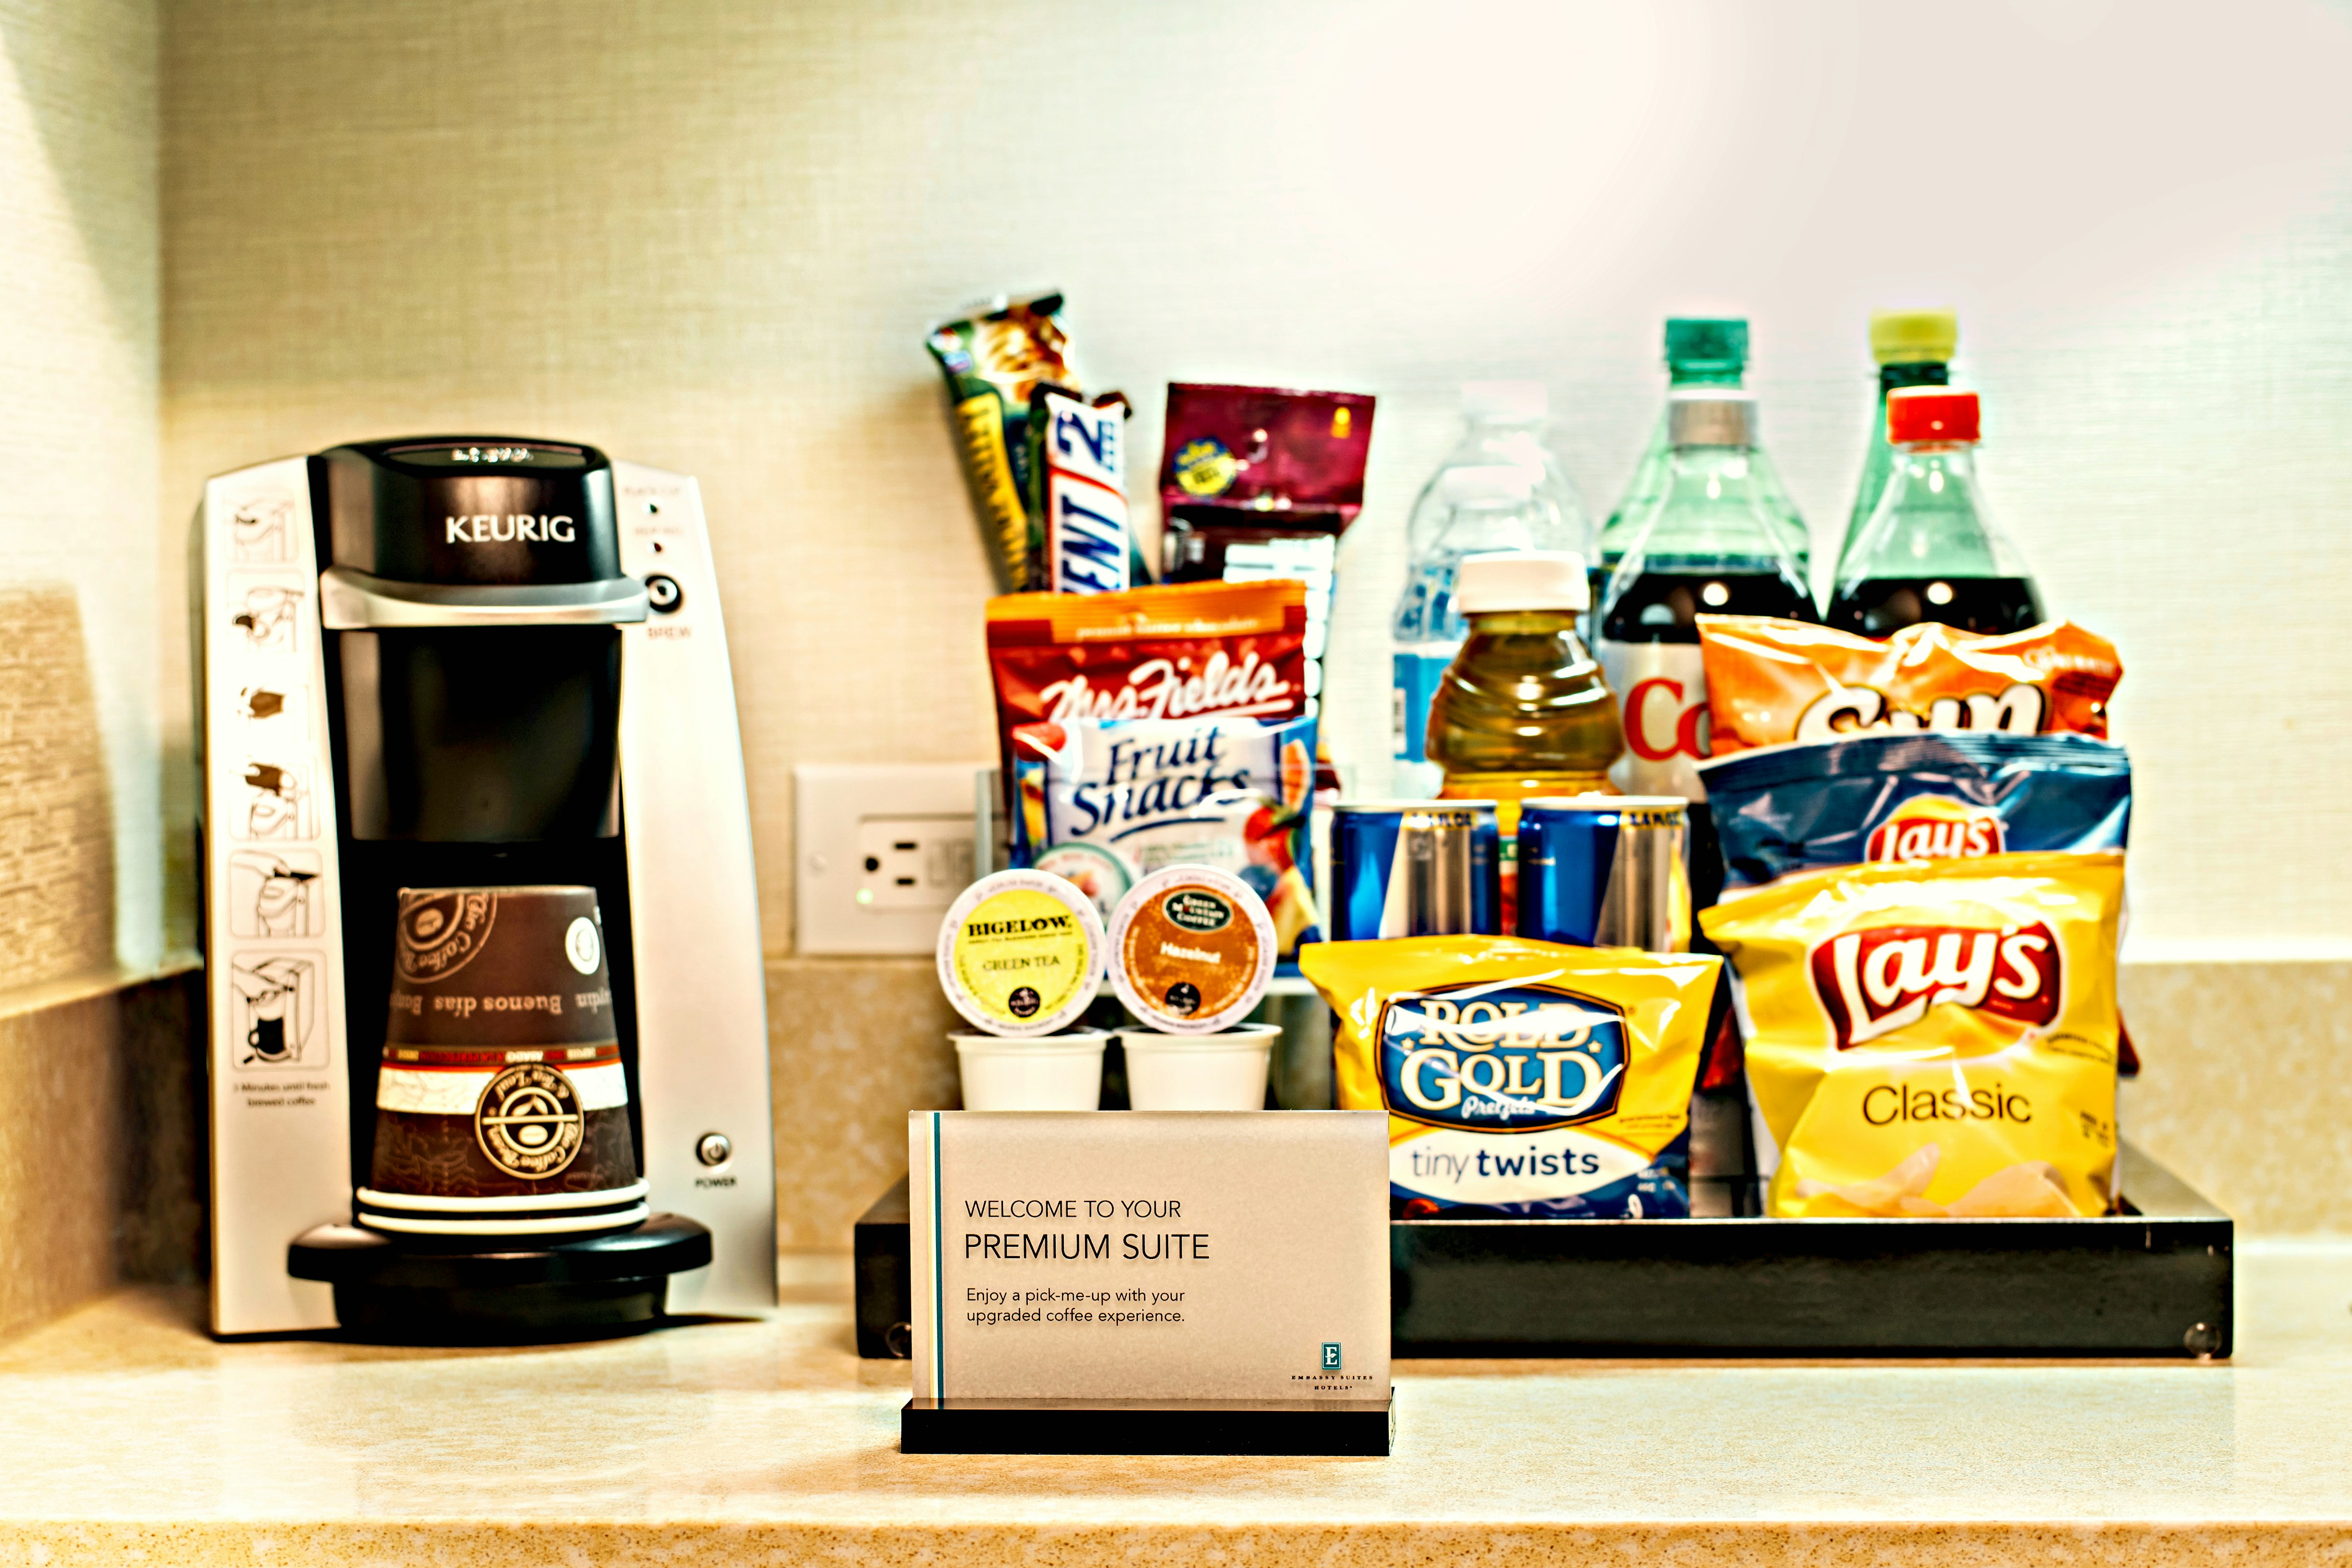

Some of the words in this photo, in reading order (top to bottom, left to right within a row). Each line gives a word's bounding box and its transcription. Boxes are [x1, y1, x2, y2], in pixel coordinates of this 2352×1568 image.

[1056, 410, 1103, 465] 2
[445, 515, 576, 543] KEURIG
[1061, 494, 1121, 593] ENT
[1128, 650, 1290, 720] Fields
[1106, 726, 1226, 785] Fruit
[1070, 762, 1251, 837] Snacks
[983, 957, 1030, 971] GREEN
[1034, 955, 1060, 967] TEA
[434, 995, 477, 1018] días
[482, 995, 562, 1015] Buenos
[1419, 1000, 1591, 1052] ROLD
[1400, 1048, 1603, 1111] GOLD
[1462, 1095, 1537, 1120] Pretzels
[1863, 1083, 2032, 1126] Classic
[1411, 1146, 1470, 1184] tiny
[1477, 1146, 1599, 1176] twists
[695, 1176, 737, 1188] POWER
[965, 1200, 1077, 1217] WELCOME
[1084, 1200, 1114, 1217] TO
[1121, 1200, 1181, 1217] YOUR
[966, 1234, 1108, 1259] PREMIUM
[1123, 1234, 1209, 1259] SUITE
[968, 1288, 1007, 1304] Enjoy
[1013, 1292, 1019, 1301] a
[1026, 1288, 1110, 1305] pick-me-up
[1116, 1288, 1146, 1301] with
[1152, 1293, 1184, 1305] your
[967, 1308, 1040, 1325] upgraded
[1047, 1308, 1092, 1321] coffee
[1099, 1309, 1184, 1326] experience.
[1326, 1347, 1337, 1365] E
